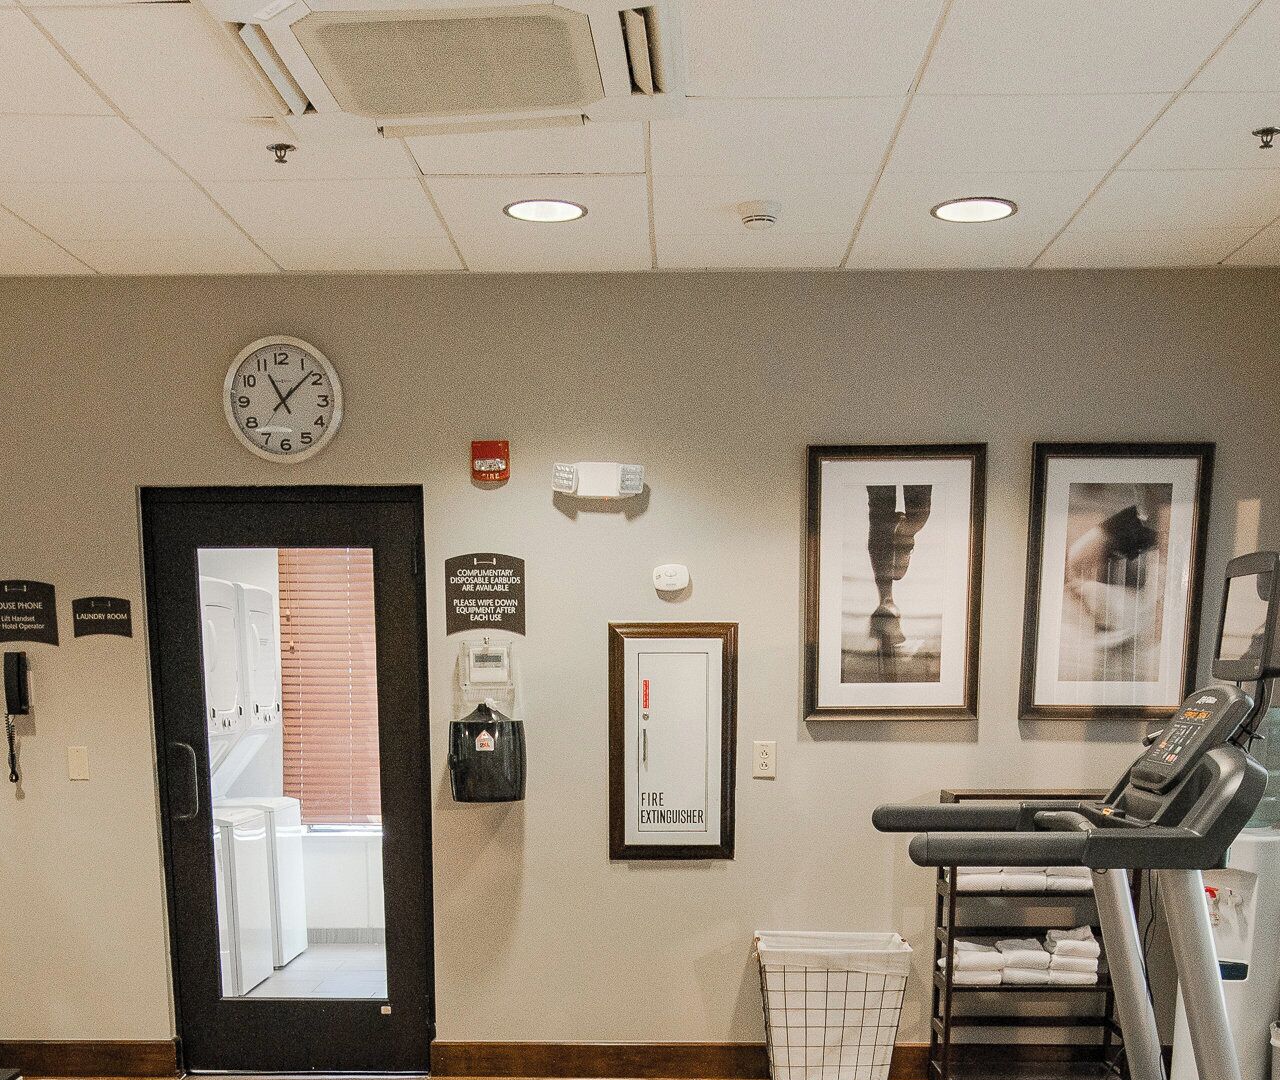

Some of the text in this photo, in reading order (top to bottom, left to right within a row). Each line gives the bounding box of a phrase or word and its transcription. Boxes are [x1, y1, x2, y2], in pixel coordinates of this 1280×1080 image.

[257, 359, 267, 371] 11
[274, 353, 288, 365] 12
[301, 358, 304, 370] 1
[243, 375, 256, 388] 10
[312, 373, 322, 385] 2
[239, 396, 250, 408] 9
[317, 395, 329, 408] 3
[246, 417, 258, 428] 8
[314, 415, 325, 427] 4
[261, 433, 271, 445] 7
[301, 432, 312, 444] 5
[281, 439, 291, 451] 6
[18, 602, 43, 610] PHONE
[19, 623, 44, 631] Operator
[641, 792, 664, 806] FIRE
[641, 810, 704, 824] EXTINGUISHER
